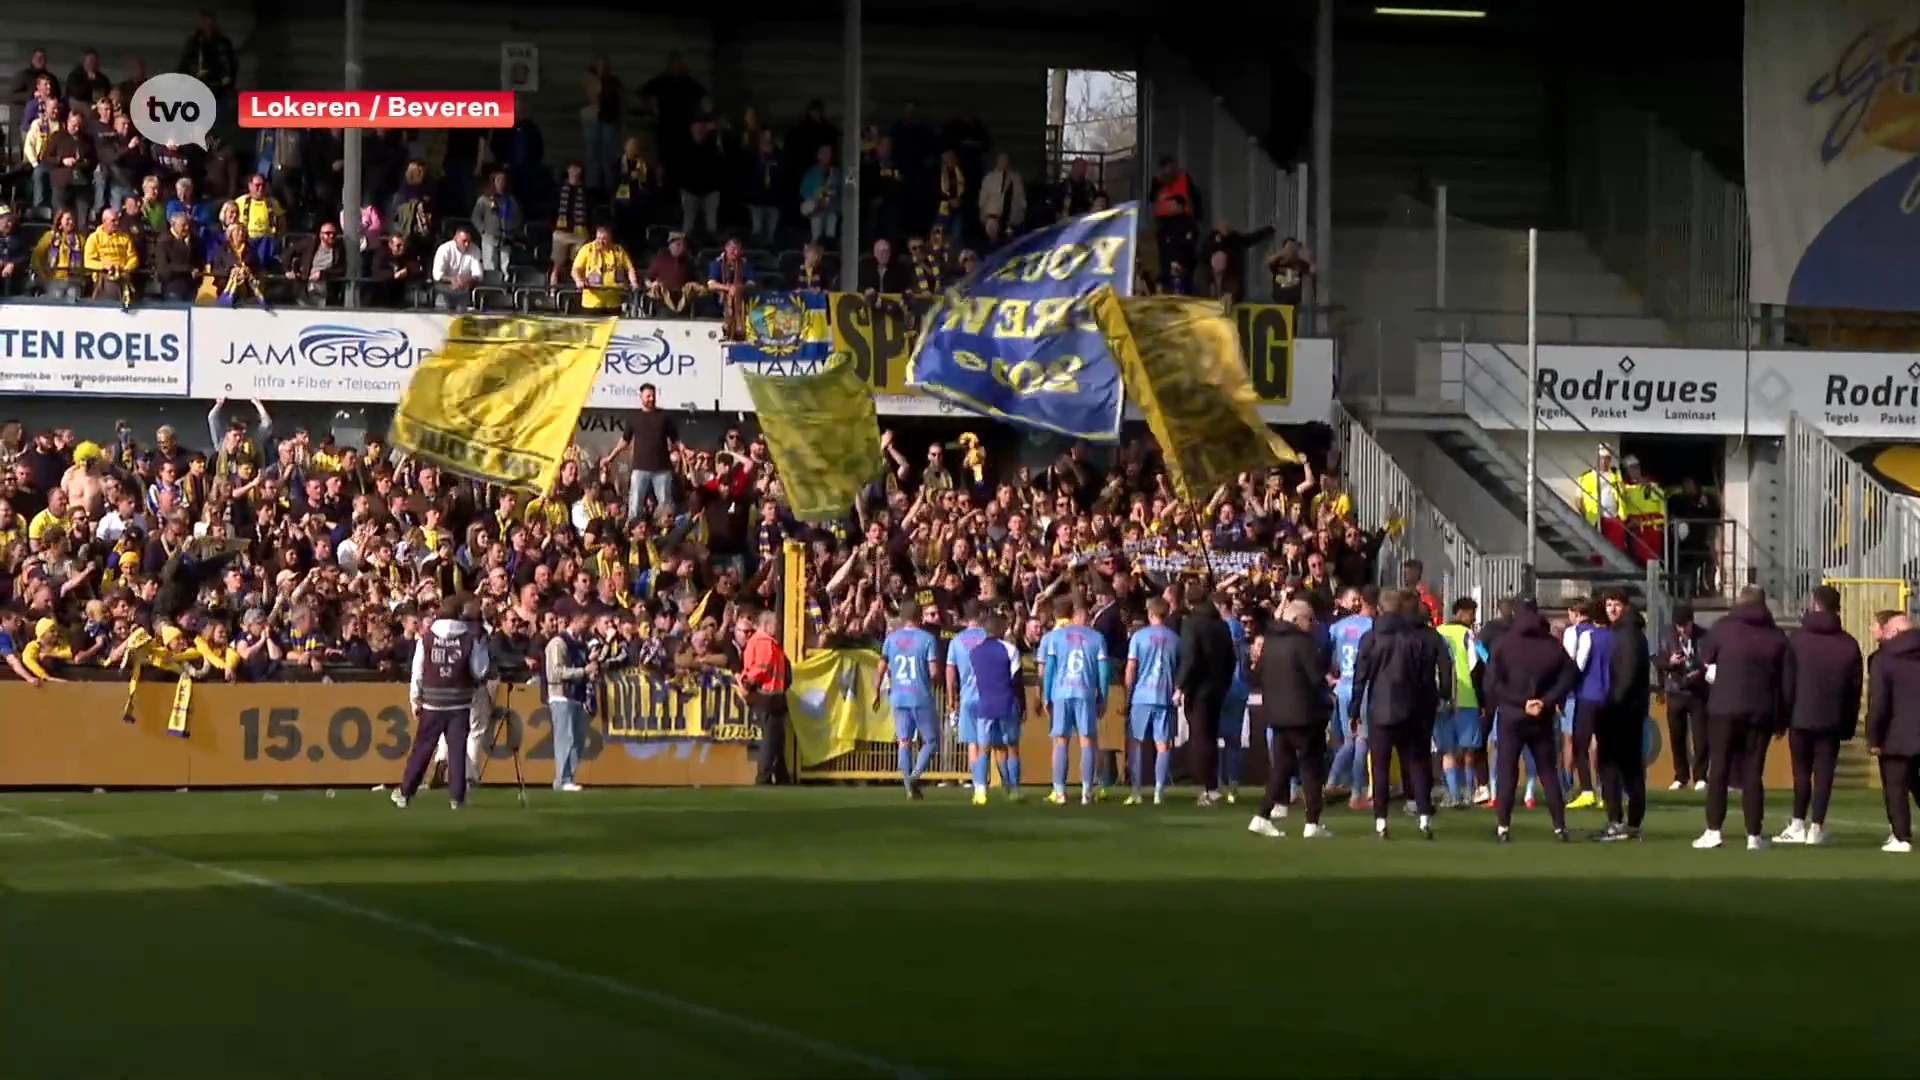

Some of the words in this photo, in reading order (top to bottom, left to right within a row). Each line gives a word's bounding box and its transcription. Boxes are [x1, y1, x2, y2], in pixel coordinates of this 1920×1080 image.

[0, 329, 64, 359] TEN
[75, 331, 179, 362] ROELS
[220, 342, 296, 366] JAM
[598, 352, 696, 376] ROUP
[253, 375, 286, 388] Infra
[297, 376, 333, 390] Fiber
[1536, 367, 1718, 412] Rodrigues
[1825, 374, 1919, 407] Rodri
[577, 416, 626, 432] VAK
[1590, 406, 1627, 419] Parket
[1664, 408, 1717, 421] Laminaat
[1824, 411, 1860, 426] Tegels
[1880, 412, 1917, 425] Parket
[894, 654, 917, 680] 21
[1067, 648, 1084, 673] 6
